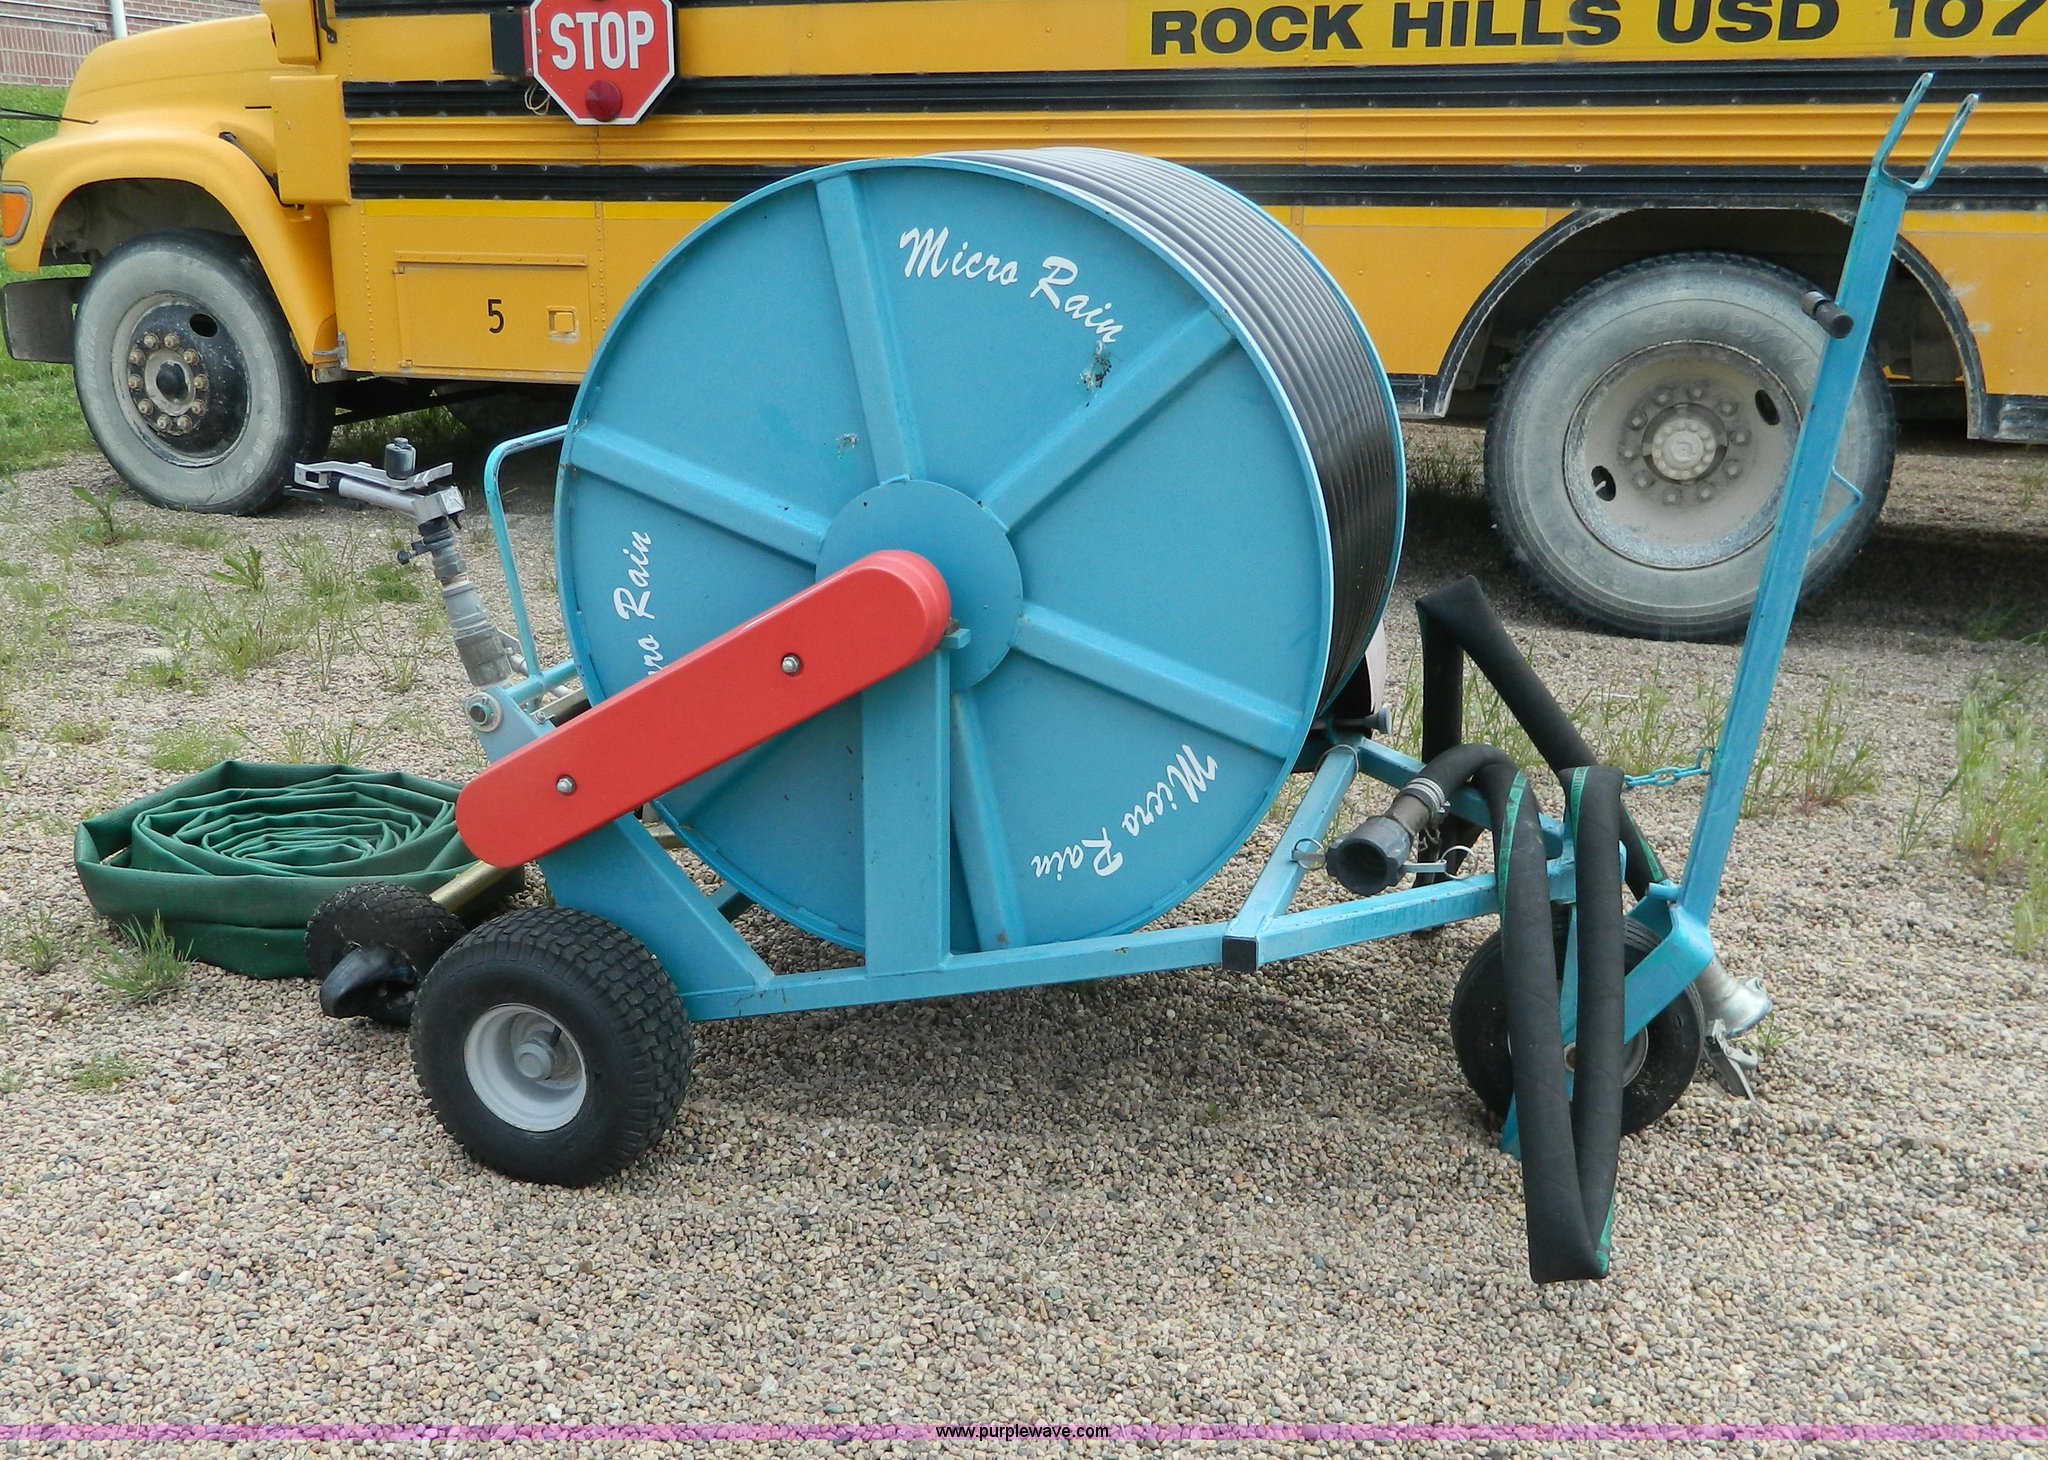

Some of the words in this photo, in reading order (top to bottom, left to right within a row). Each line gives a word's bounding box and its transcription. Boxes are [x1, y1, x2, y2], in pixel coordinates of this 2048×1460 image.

[550, 10, 655, 71] STOP
[1151, 4, 1363, 55] ROCK
[1391, 0, 1622, 48] HILLS
[1656, 0, 1840, 43] USD
[900, 226, 1019, 286] Micro
[1029, 255, 1124, 343] Rain
[487, 298, 505, 334] 5
[613, 531, 656, 620] Rain
[1121, 744, 1218, 837] Micro
[1031, 827, 1124, 881] Rain
